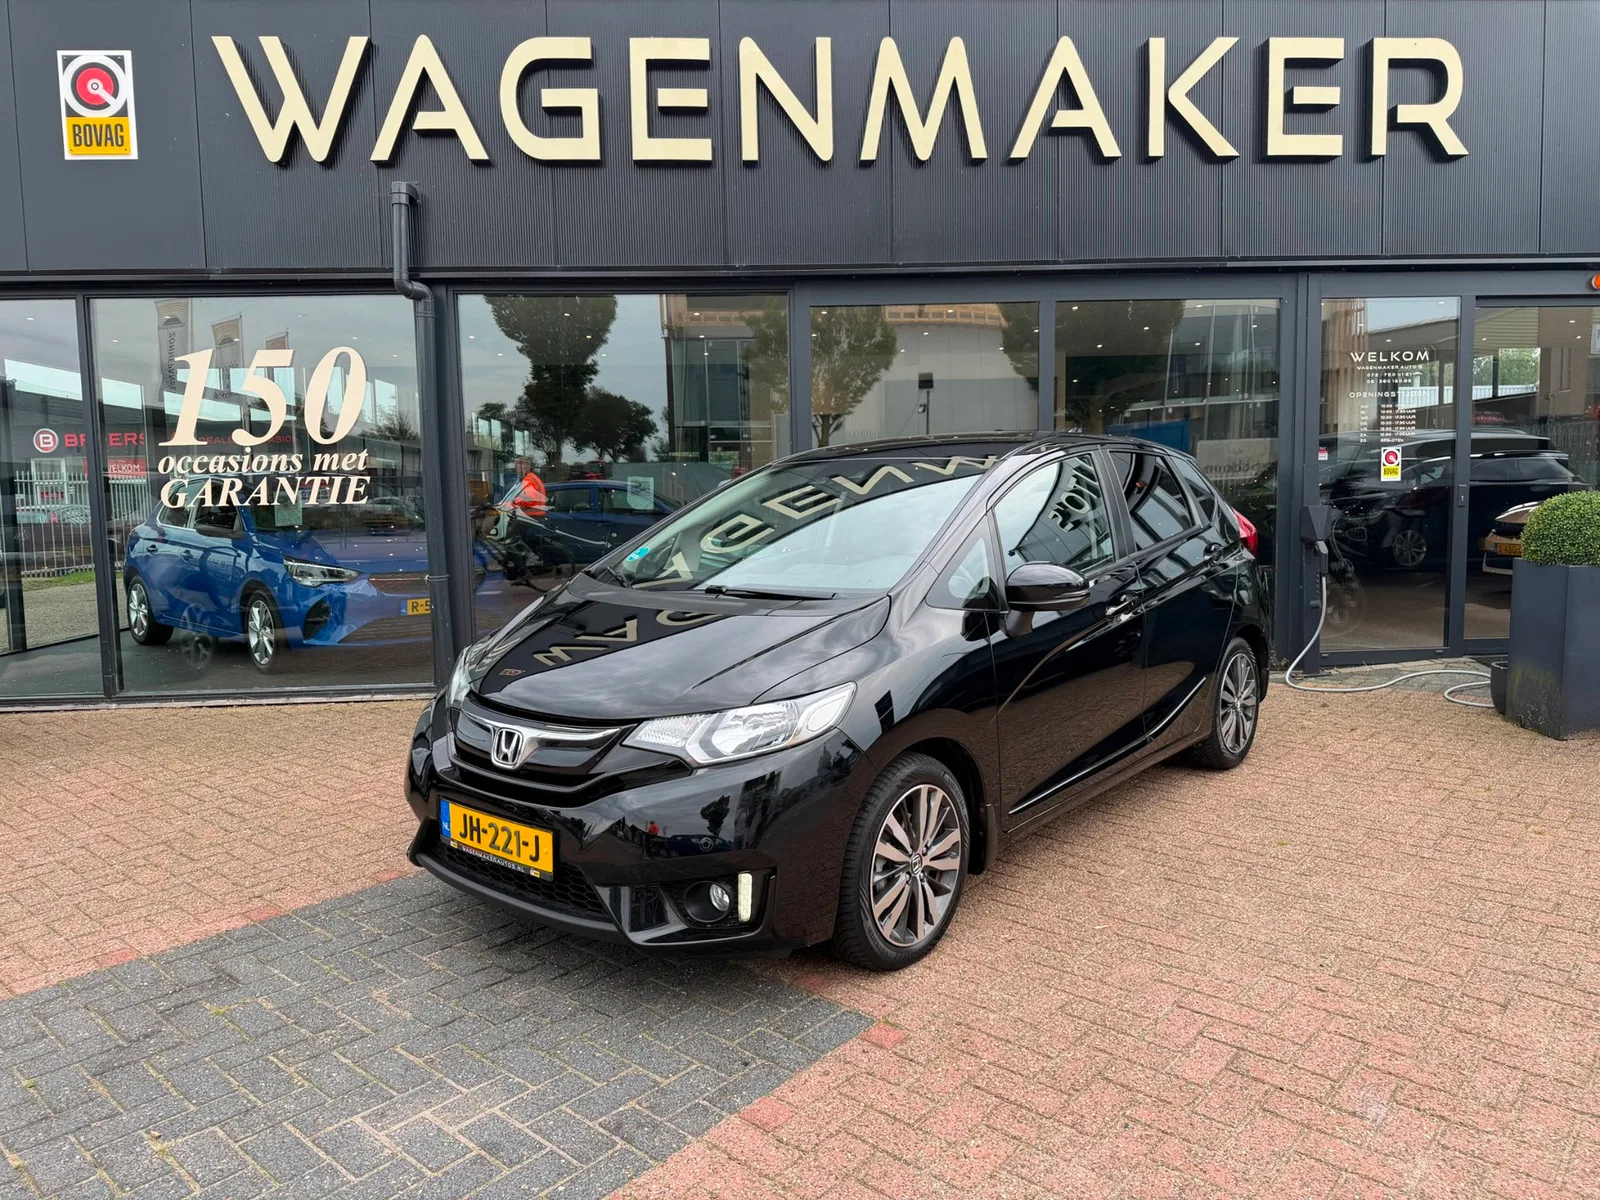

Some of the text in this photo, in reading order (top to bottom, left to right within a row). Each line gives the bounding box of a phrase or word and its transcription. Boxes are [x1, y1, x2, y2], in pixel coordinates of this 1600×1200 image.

[211, 35, 1468, 162] WAGENMAKER
[72, 124, 125, 147] BOVAG
[1350, 351, 1429, 362] WELKOM
[158, 346, 368, 446] 150
[158, 446, 369, 474] occasions met
[160, 476, 371, 508] GARANTIE
[459, 813, 540, 862] JH-221-J
